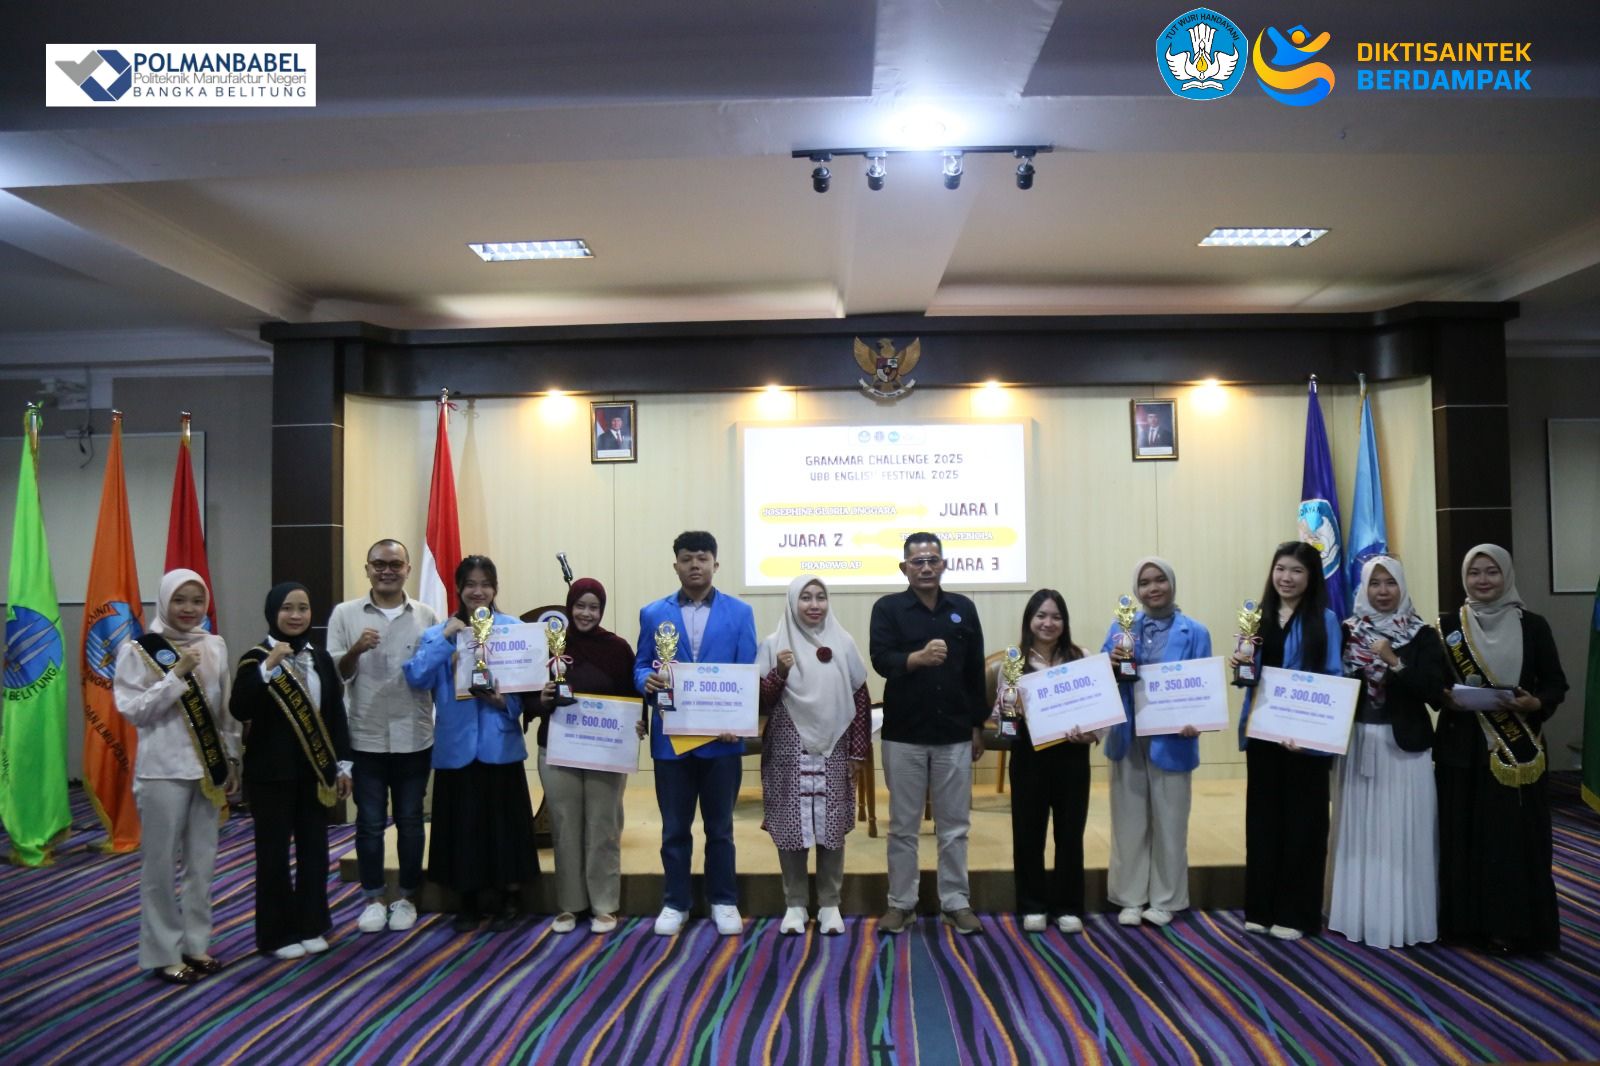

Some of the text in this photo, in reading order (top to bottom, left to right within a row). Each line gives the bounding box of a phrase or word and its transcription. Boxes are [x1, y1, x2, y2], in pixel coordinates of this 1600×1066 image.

[805, 453, 963, 466] GRAMMAR CHALLENGE 2025
[810, 471, 830, 481] UBB
[881, 470, 926, 480] FESTIVAL
[931, 470, 959, 480] 2025
[939, 502, 988, 517] JUARA
[778, 533, 843, 548] JUARA 2
[945, 557, 1000, 571] UARA 3
[8, 667, 57, 701] BELITUNG
[683, 680, 743, 694] RP. 500.000,-
